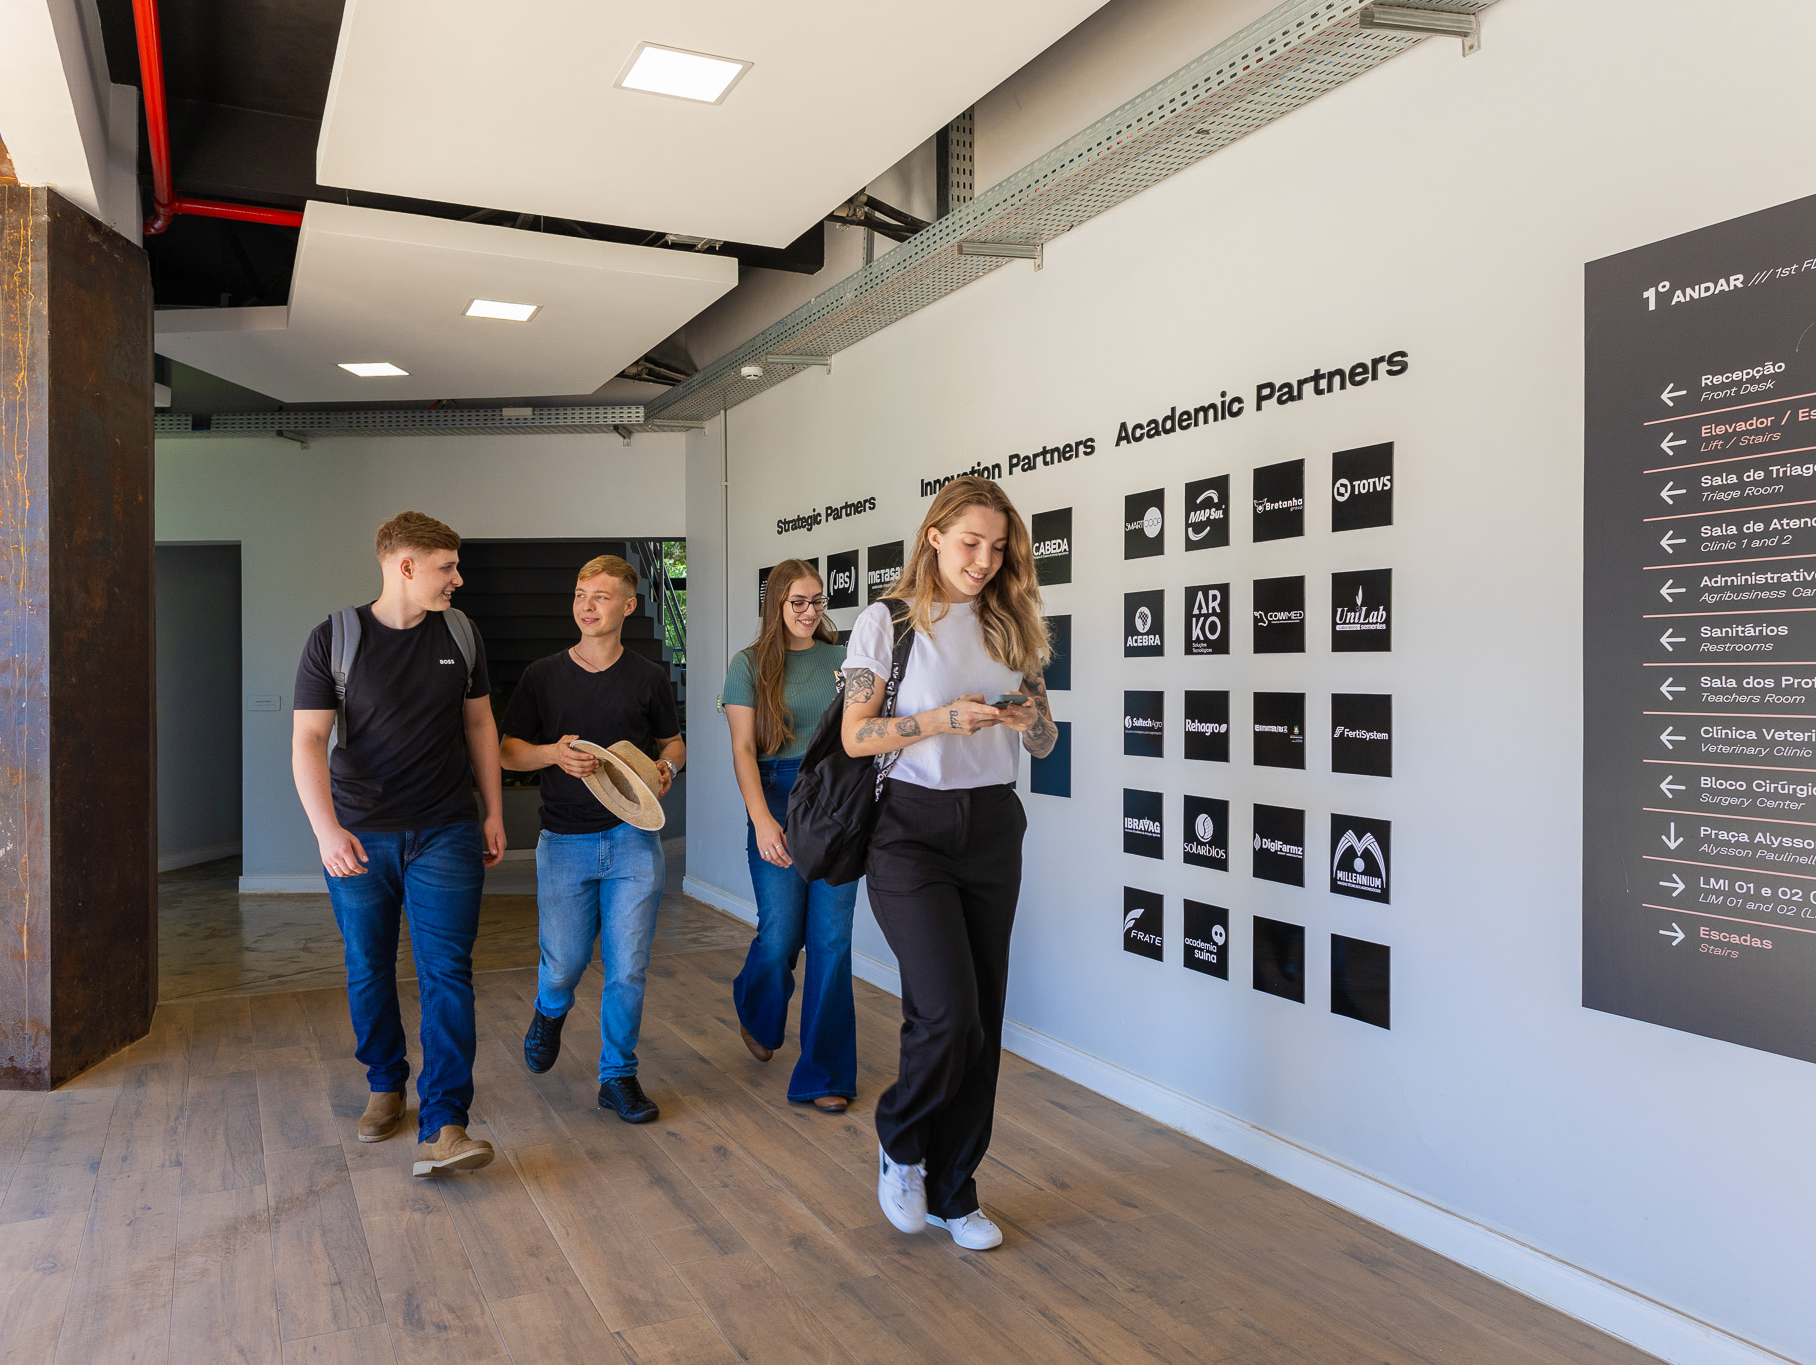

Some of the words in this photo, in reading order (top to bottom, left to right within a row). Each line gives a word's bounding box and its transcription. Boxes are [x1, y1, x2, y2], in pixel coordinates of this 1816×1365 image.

[1671, 274, 1744, 305] ANDAR
[1776, 264, 1798, 278] 1st
[1702, 362, 1785, 387] Recepção
[1115, 390, 1244, 447] Academic
[1255, 350, 1409, 412] Partners
[1701, 386, 1737, 402] Front
[1740, 379, 1776, 395] Desk
[1702, 417, 1775, 437] Elevador
[1781, 410, 1791, 425] /
[1701, 440, 1724, 452] Lift
[1726, 437, 1737, 448] /
[1739, 432, 1781, 446] Stairs
[921, 461, 1002, 497] Innotion
[1008, 437, 1096, 476] Partners
[1701, 473, 1738, 487] Sala
[1743, 469, 1764, 482] de
[1769, 464, 1816, 478] Triag
[1352, 475, 1391, 495] TOTVS
[1702, 490, 1740, 502] Triage
[1744, 484, 1784, 497] Room
[1265, 497, 1303, 511] Bretanha
[777, 508, 822, 535] Strategic
[825, 496, 876, 523] Partners
[1701, 523, 1738, 537] Sala
[1743, 520, 1764, 533] de
[1033, 538, 1069, 556] CABEDA
[1701, 540, 1736, 552] Clinic
[1741, 539, 1748, 549] 1
[1751, 536, 1779, 548] and
[1781, 534, 1792, 545] 2
[833, 571, 850, 590] JBS
[1700, 569, 1816, 588] Administrativ
[1192, 589, 1221, 615] AR
[1699, 589, 1786, 604] Agribusiness
[1268, 610, 1304, 620] COWMED
[1335, 605, 1387, 624] UniLab
[1192, 616, 1221, 641] KO
[1700, 623, 1788, 637] Sanitários
[1126, 634, 1161, 647] ACEBRA
[1700, 642, 1774, 652] Restrooms
[1700, 675, 1737, 688] Sala
[1742, 675, 1775, 688] dos
[1701, 692, 1761, 703] Teachers
[1764, 693, 1805, 704] Room
[1185, 718, 1220, 736] Rehagro
[1344, 728, 1389, 741] FertiSystem
[1700, 726, 1757, 740] Clínica
[1762, 728, 1816, 742] Veteri
[1701, 743, 1770, 757] Veterinary
[1773, 746, 1813, 758] Clinic
[1700, 776, 1746, 791] Bloco
[1700, 792, 1752, 808] Surgery
[1756, 797, 1806, 810] Center
[1124, 817, 1160, 833] IBRAVAG
[1262, 838, 1303, 855] DigiFarmz
[1700, 826, 1749, 844] Praça
[1754, 832, 1816, 850] Alysso
[1699, 843, 1752, 858] Alysson
[1337, 870, 1381, 889] MILLENNIUM
[1700, 876, 1729, 891] LMI
[1735, 881, 1754, 895] 01
[1761, 887, 1772, 897] e
[1778, 887, 1803, 902] 02
[1699, 893, 1724, 905] LIM
[1726, 897, 1743, 908] 01
[1746, 901, 1774, 912] and
[1776, 904, 1797, 916] 02
[1800, 907, 1816, 919] (L
[1131, 929, 1162, 947] FRATE
[1184, 936, 1217, 953] academia
[1699, 926, 1773, 949] Escadas
[1194, 949, 1217, 964] suína
[1699, 943, 1739, 959] Stairs
